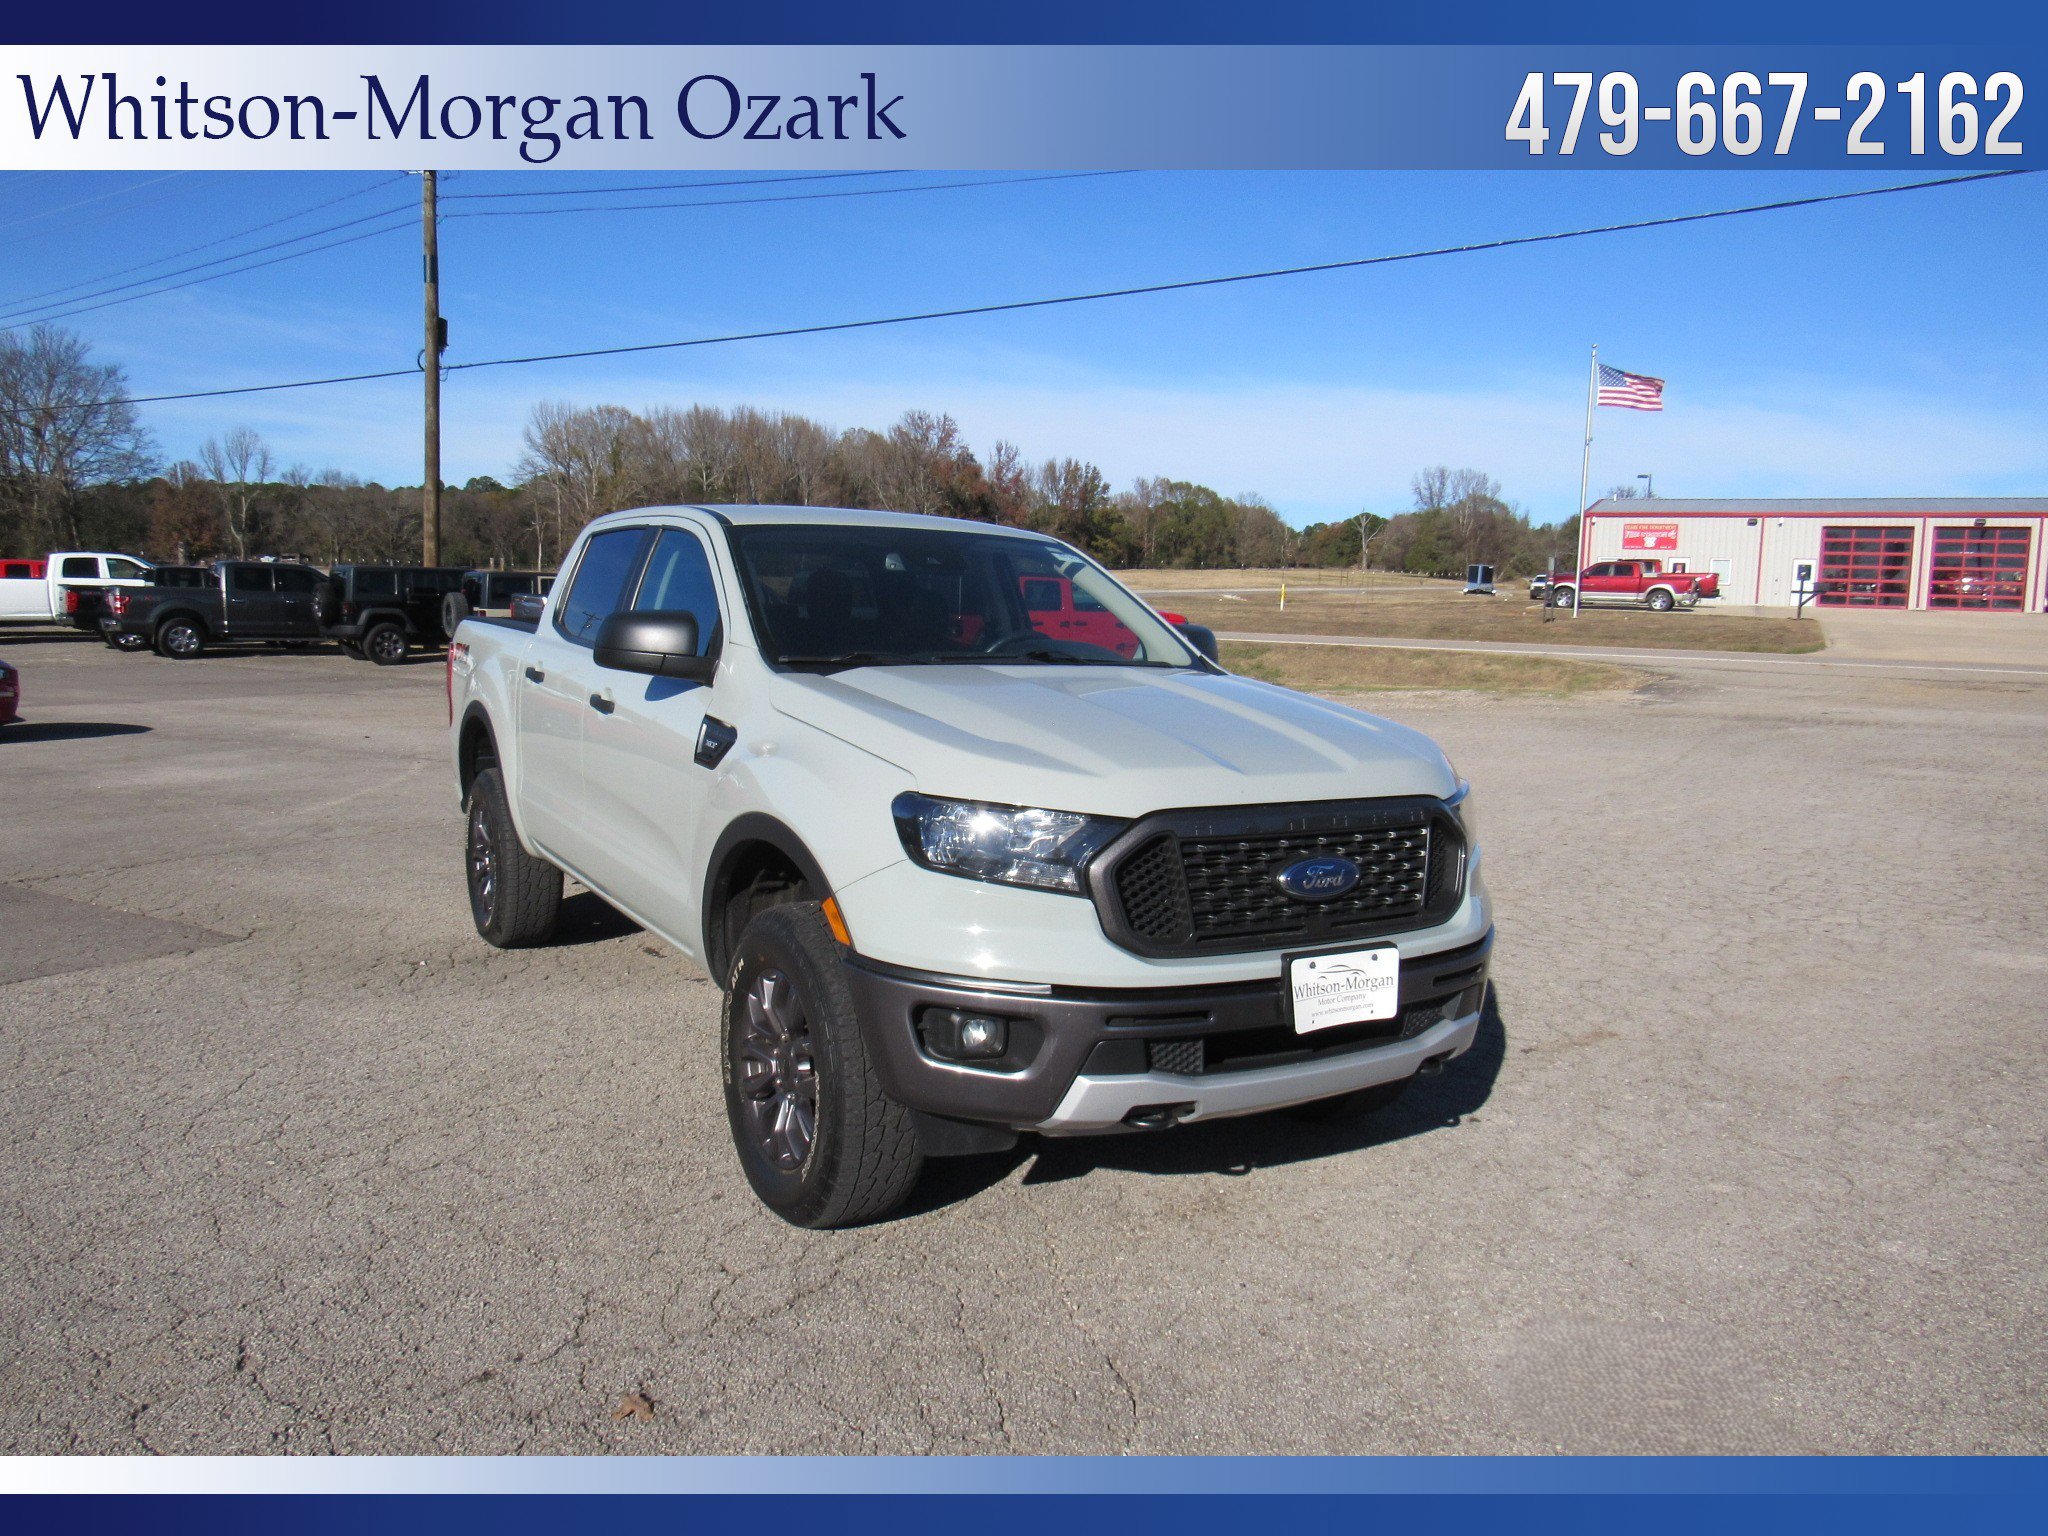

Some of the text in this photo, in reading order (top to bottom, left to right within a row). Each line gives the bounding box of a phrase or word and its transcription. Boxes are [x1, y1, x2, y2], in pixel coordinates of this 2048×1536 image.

[1303, 865, 1345, 889] Ford
[1294, 975, 1394, 999] Whitson-Morgan
[1318, 993, 1367, 1006] Motor Company
